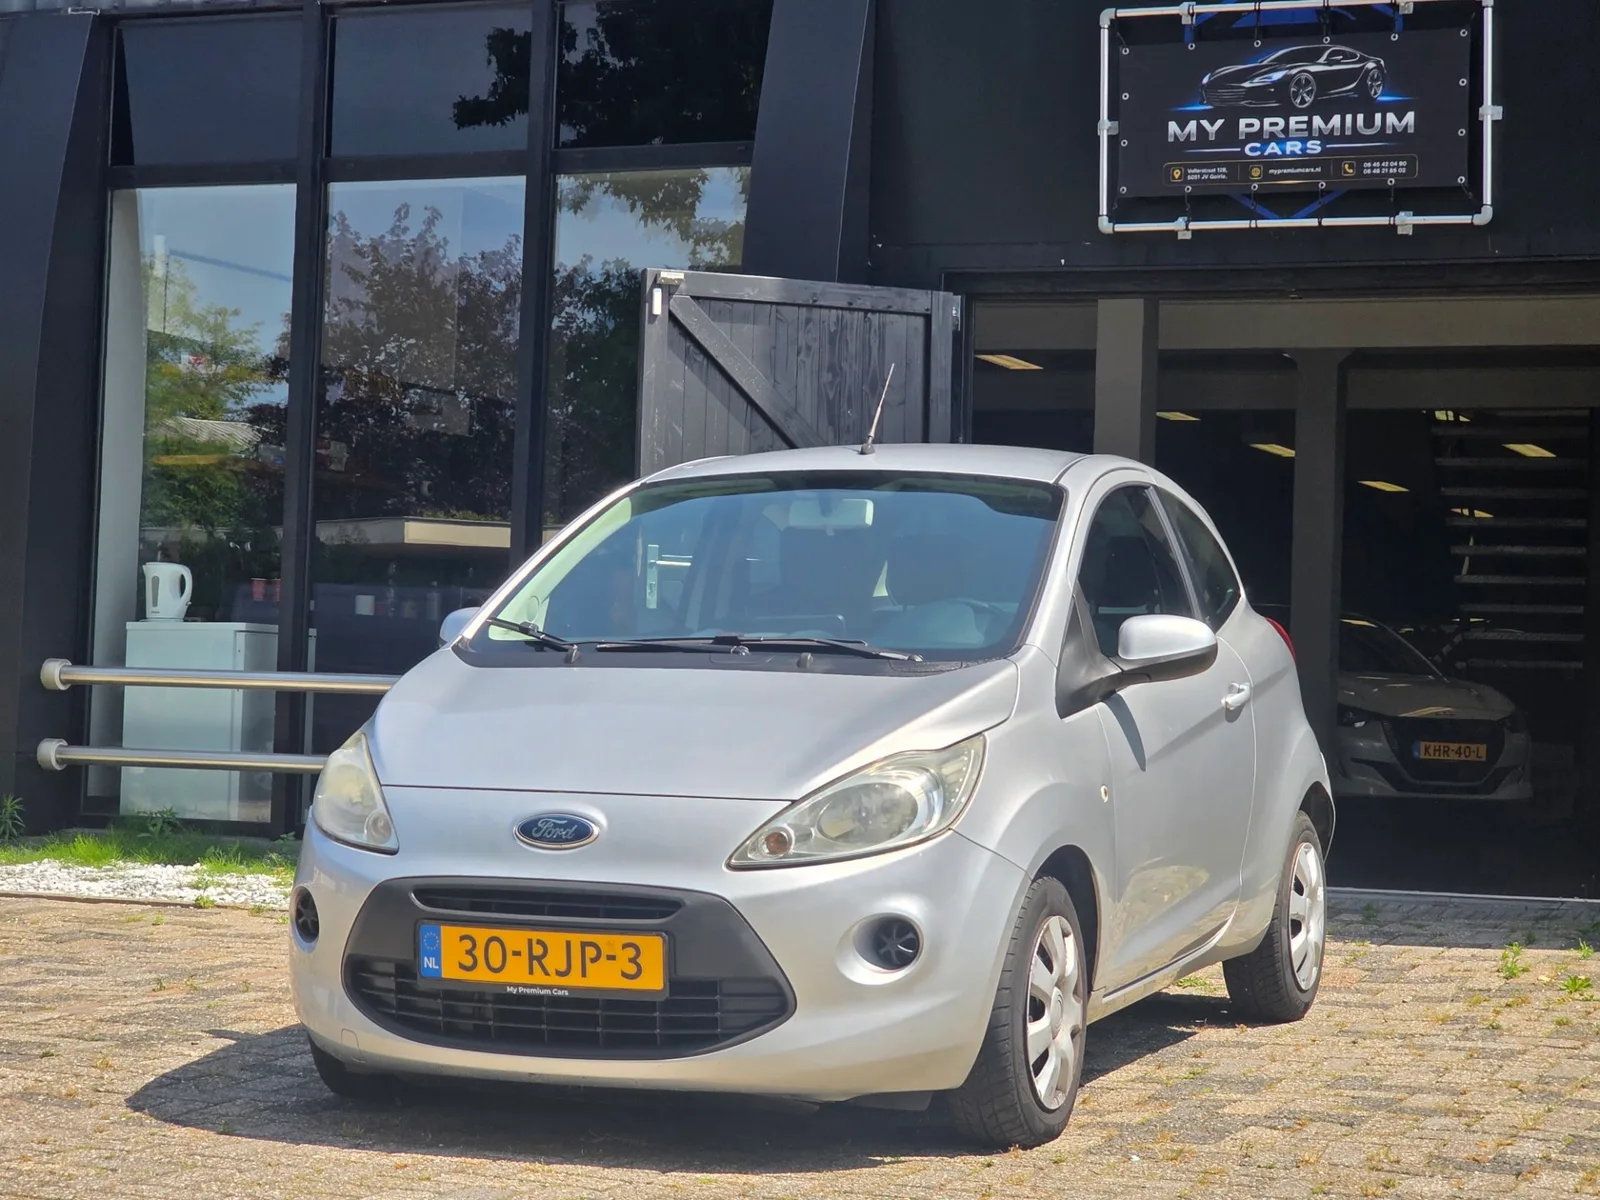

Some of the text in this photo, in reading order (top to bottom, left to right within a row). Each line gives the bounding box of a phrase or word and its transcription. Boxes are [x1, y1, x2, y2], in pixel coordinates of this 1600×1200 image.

[1168, 111, 1415, 142] MY PREMIUM
[1244, 139, 1322, 157] CARS
[1268, 166, 1322, 175] mypremiumcars.nl
[1423, 743, 1484, 759] KHR-40-L
[531, 818, 579, 839] Ford
[423, 955, 439, 970] NL
[457, 933, 644, 981] 30-RJP-3
[506, 985, 569, 996] My Premium Cars
